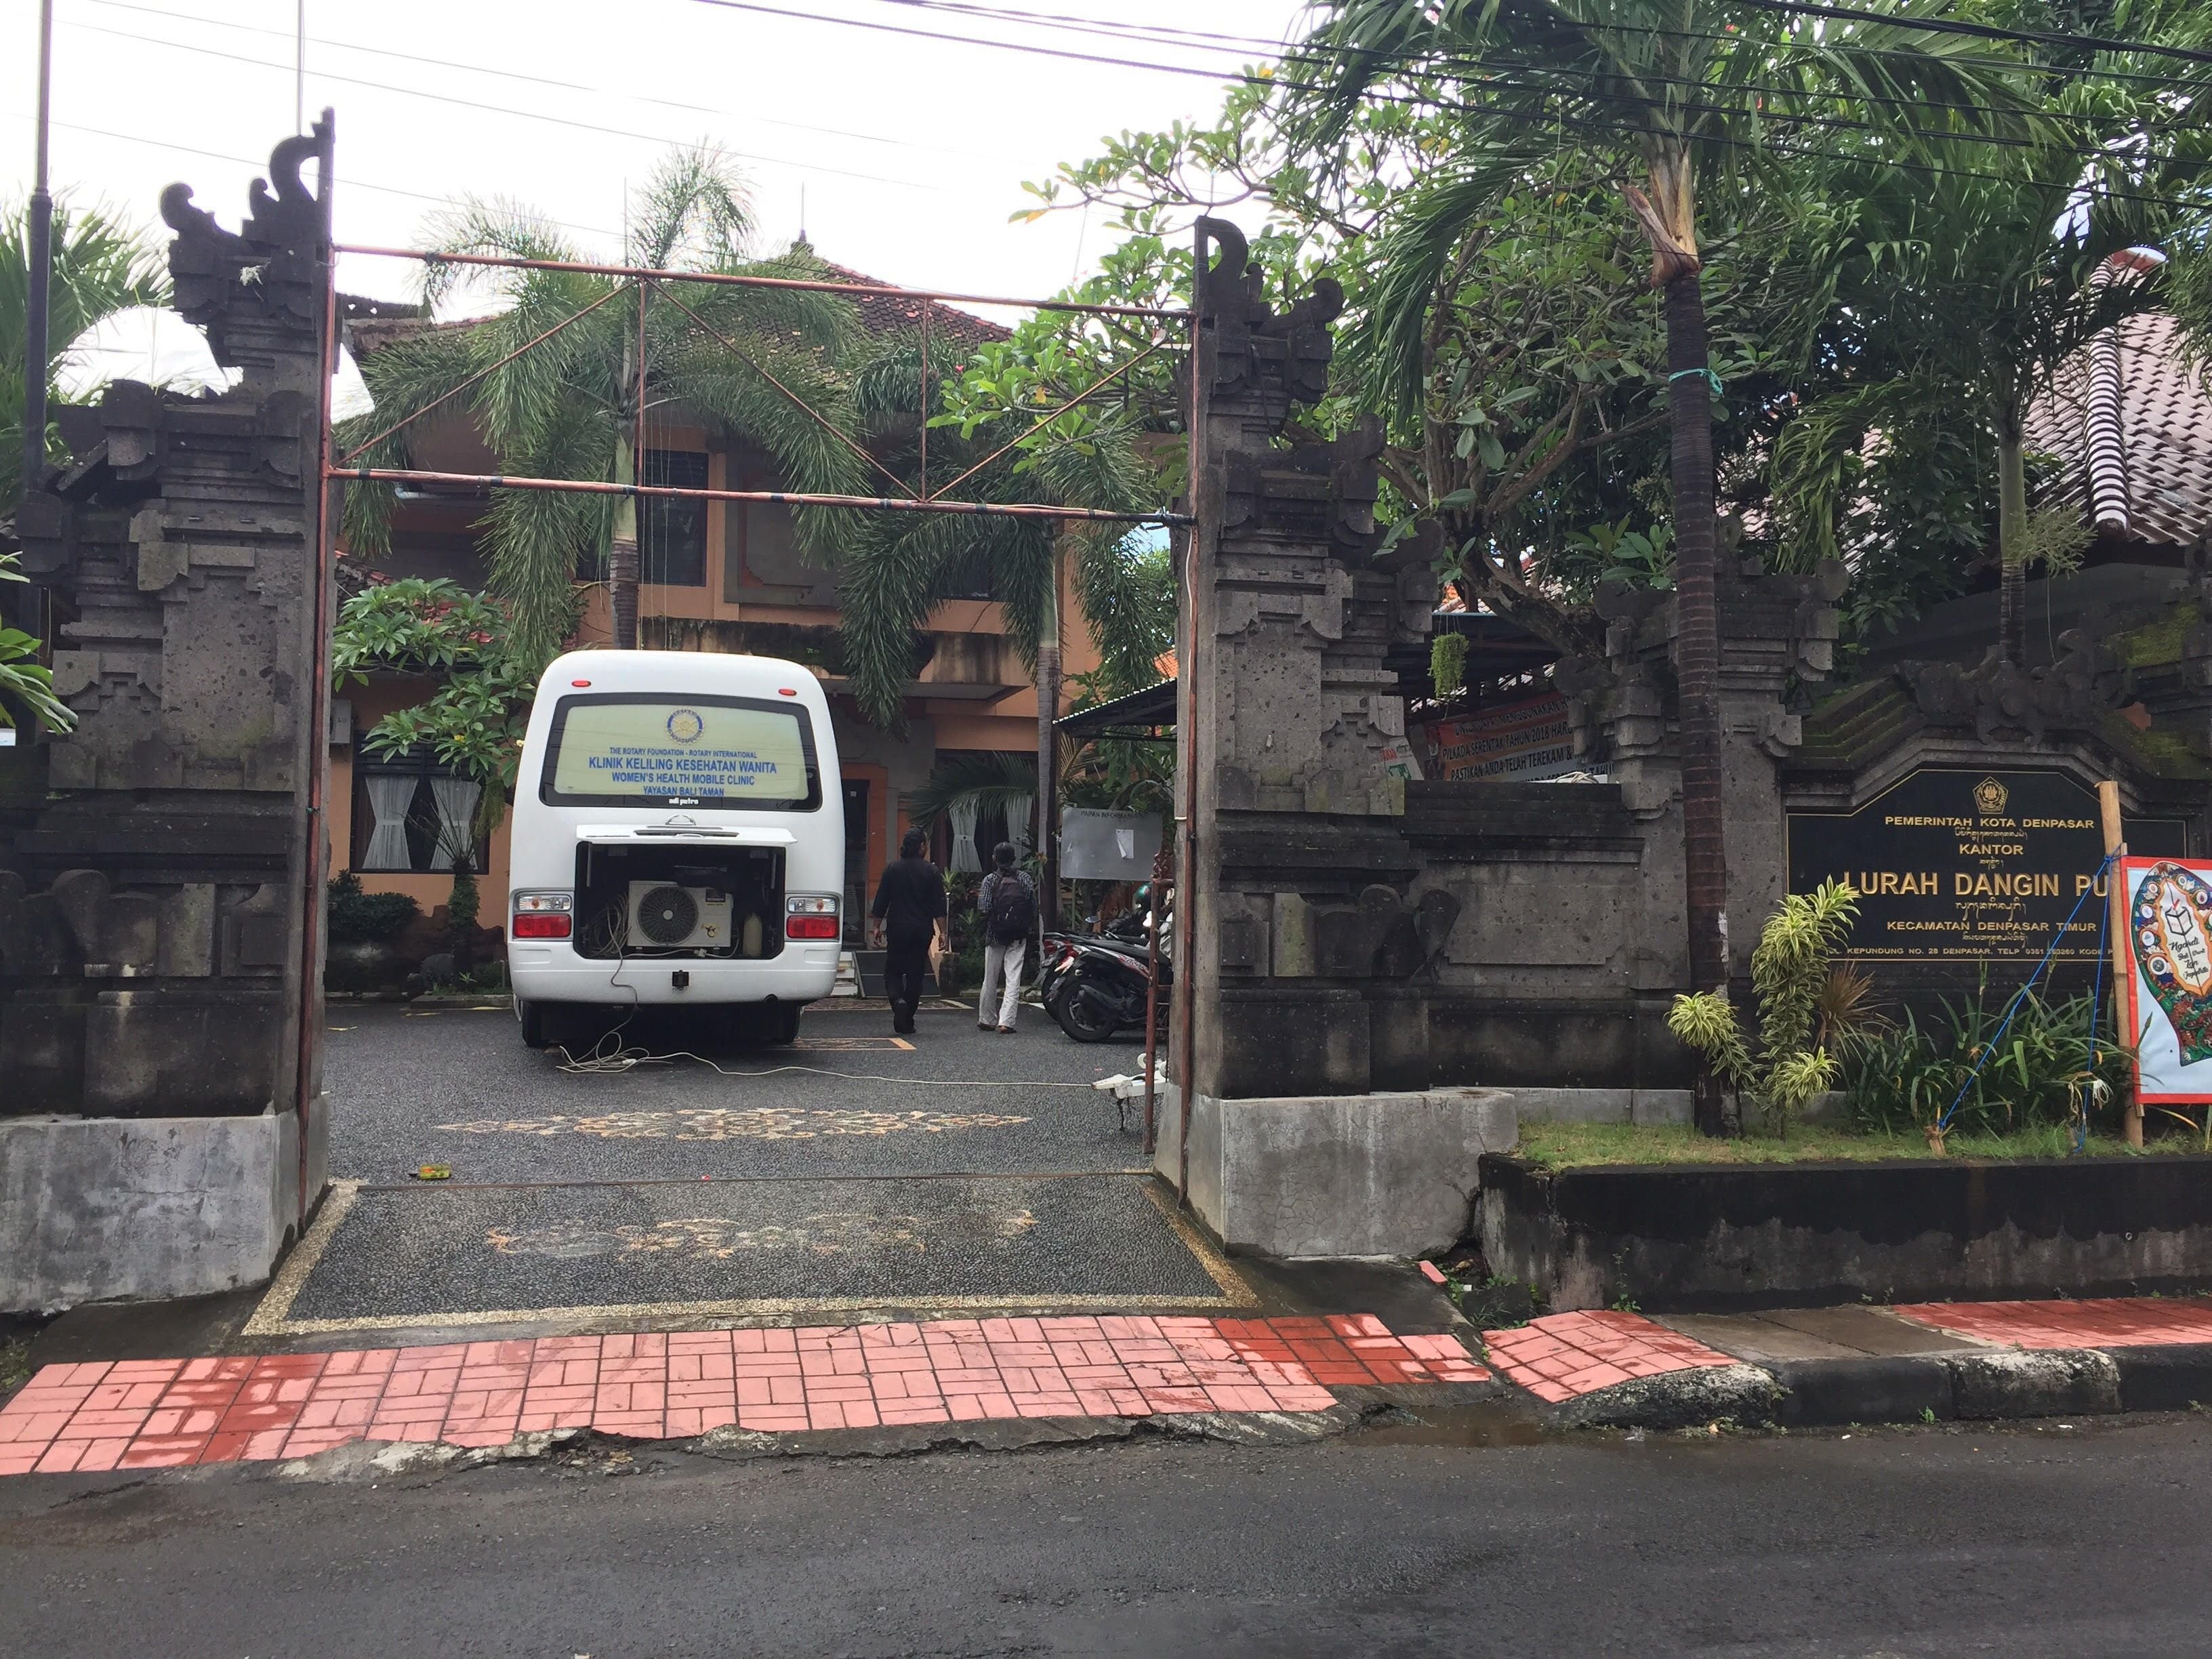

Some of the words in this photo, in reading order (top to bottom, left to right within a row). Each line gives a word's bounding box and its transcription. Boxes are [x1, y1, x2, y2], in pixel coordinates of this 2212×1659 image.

[1442, 743, 1470, 760] PILKADA
[1471, 734, 1504, 756] SERENTAK
[1505, 728, 1530, 748] TAHUN
[1532, 725, 1550, 743] 2018
[622, 747, 646, 756] ROTARY
[647, 749, 684, 757] FOUNDATION
[689, 750, 712, 758] ROTARY
[589, 757, 623, 769] KLINIK
[626, 758, 673, 771] KELILING
[676, 759, 737, 773] KESEHATAN
[739, 760, 777, 774] WANITA
[1450, 762, 1483, 781] PASTIKAN
[1485, 758, 1504, 777] ANDA
[1504, 753, 1525, 773] TELAH
[1528, 747, 1564, 766] TEREKAM
[611, 772, 654, 783] WOMEN'S
[656, 773, 691, 784] HEALTH
[692, 774, 725, 785] MOBILE
[726, 775, 755, 786] CLINIC
[643, 786, 678, 796] YAYASAN
[680, 787, 697, 796] BALI
[699, 787, 724, 797] TAMAN
[1885, 817, 1972, 827] PEMERINTAH
[1980, 818, 2016, 827] KOTA
[2023, 819, 2094, 830] DENPASAR
[1959, 844, 2024, 855] KANTOR
[1843, 872, 1938, 895] LURAH
[1955, 872, 2059, 897] DANGIN
[1887, 921, 1970, 931] KECAMATAN
[1978, 922, 2049, 933] DENPASAR
[2056, 922, 2096, 933] TIMUR
